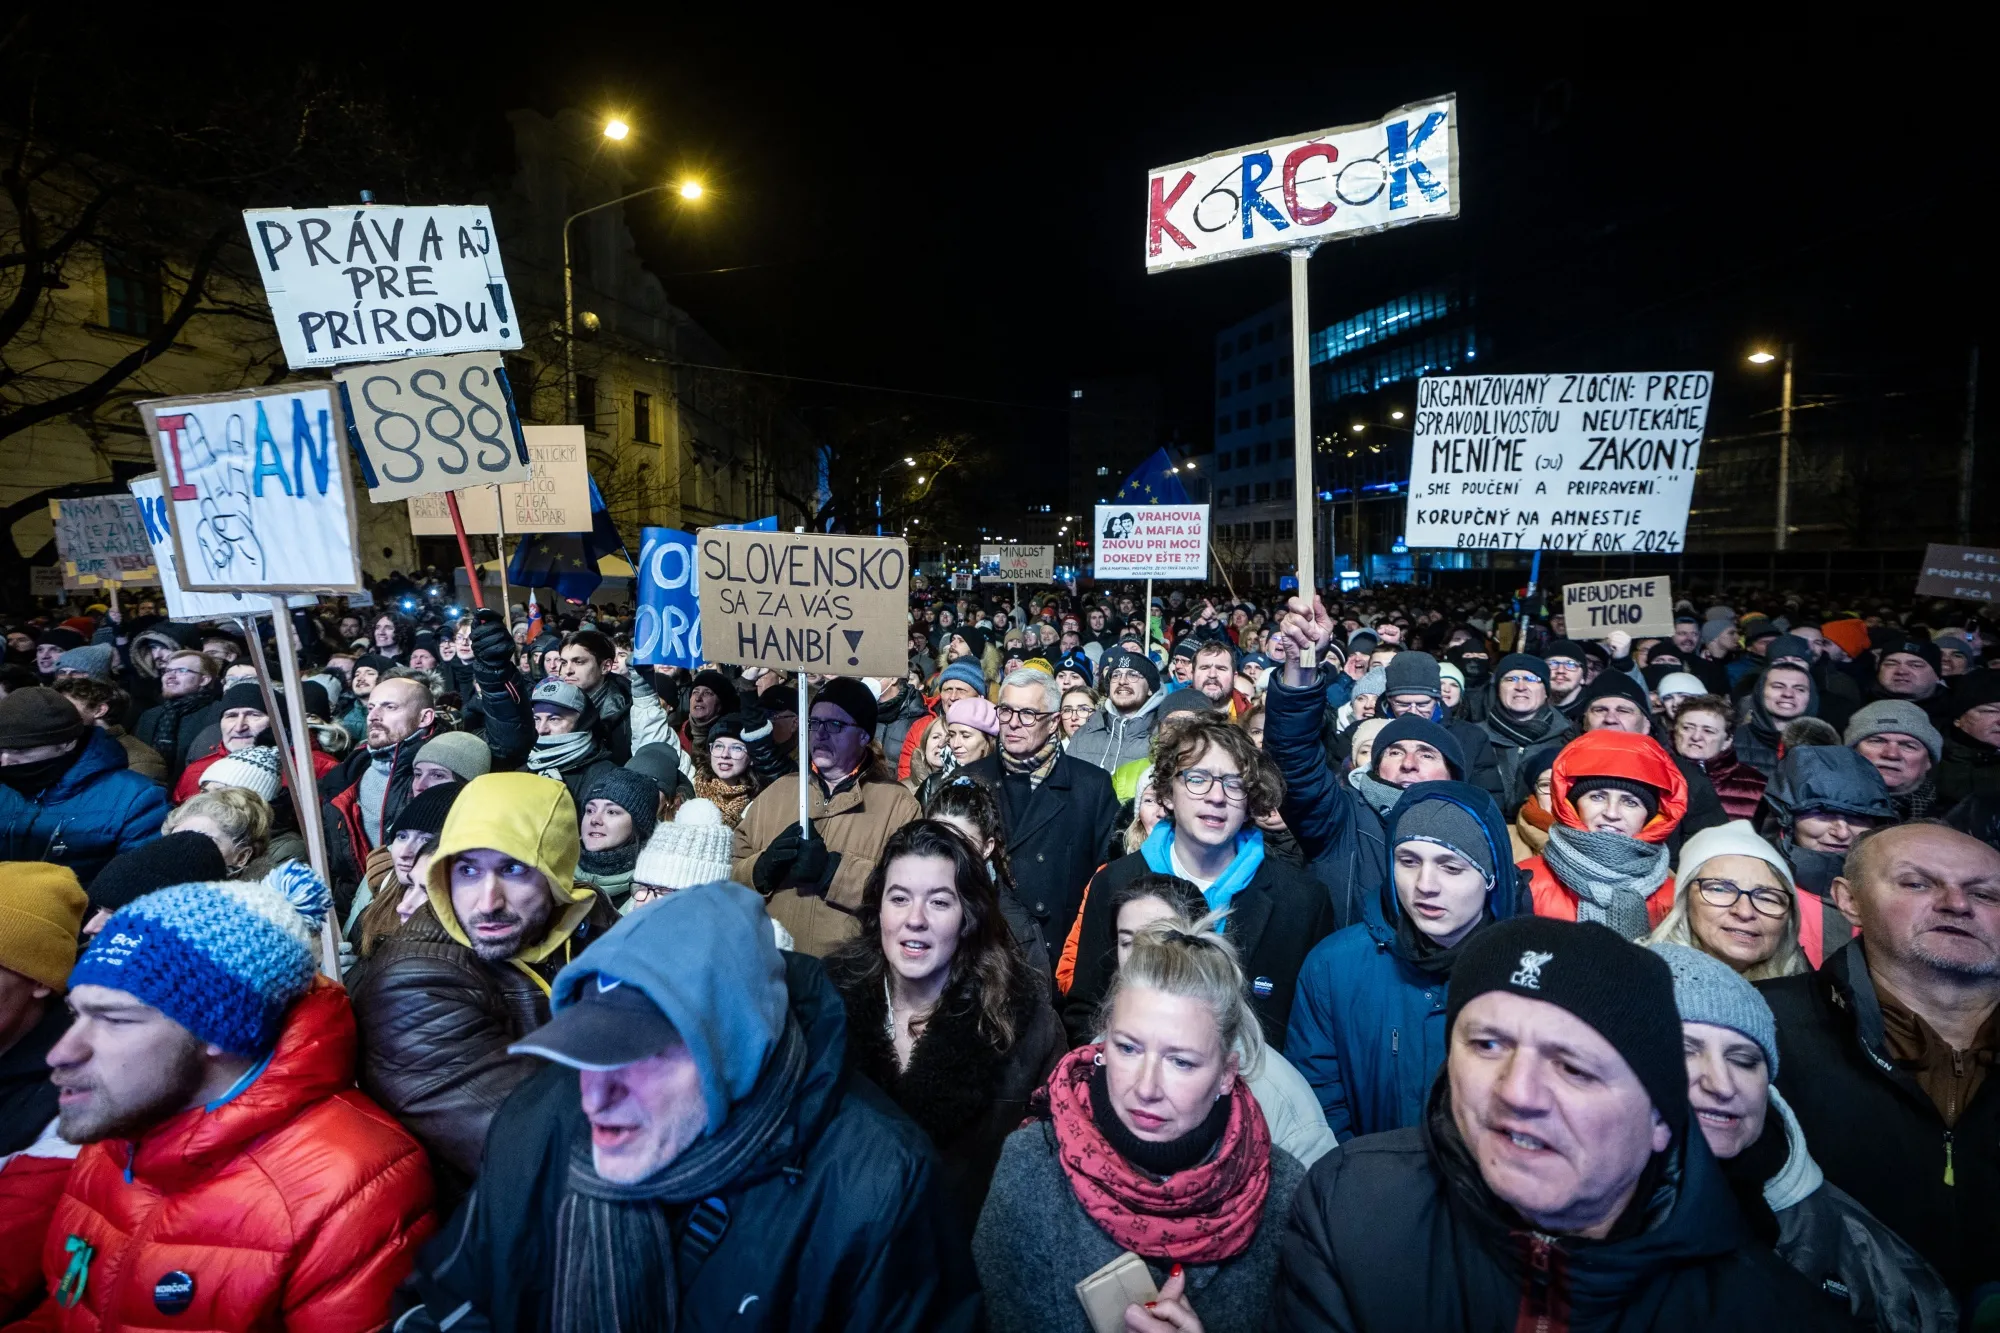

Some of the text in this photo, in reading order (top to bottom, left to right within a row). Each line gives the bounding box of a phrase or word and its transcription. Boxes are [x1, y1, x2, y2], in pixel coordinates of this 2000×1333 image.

[256, 210, 490, 271] PRÁVA AJ
[342, 266, 438, 299] PRE
[1420, 374, 1709, 408] ORGANIZOVANÝ ZLOČIN: PRED
[1582, 403, 1704, 433] NEUTEKÁME,
[1431, 436, 1527, 474] MENÍME
[523, 480, 555, 493] FICO
[1462, 478, 1522, 495] POUČENÍ
[1535, 483, 1547, 494] A
[518, 508, 565, 524] GAŠPAR
[1137, 511, 1201, 521] VRAHOVIA
[1417, 507, 1641, 526] KORUPČNÝ NA AMNESTIE
[1134, 523, 1201, 535] A MAFIA SÚ
[1102, 540, 1200, 549] ZNOVU PRI MOCI
[1457, 528, 1680, 553] BOHATÝ NOVÝ ROK 2024
[704, 540, 904, 590] SLOVENSKO
[1103, 551, 1200, 563] DOKEDY EŠTE ???
[1000, 569, 1043, 579] DOBEHNE
[1568, 581, 1655, 605] NEBUDEME
[720, 588, 853, 621] SA ZA VÁS
[1588, 604, 1642, 626] TICHO
